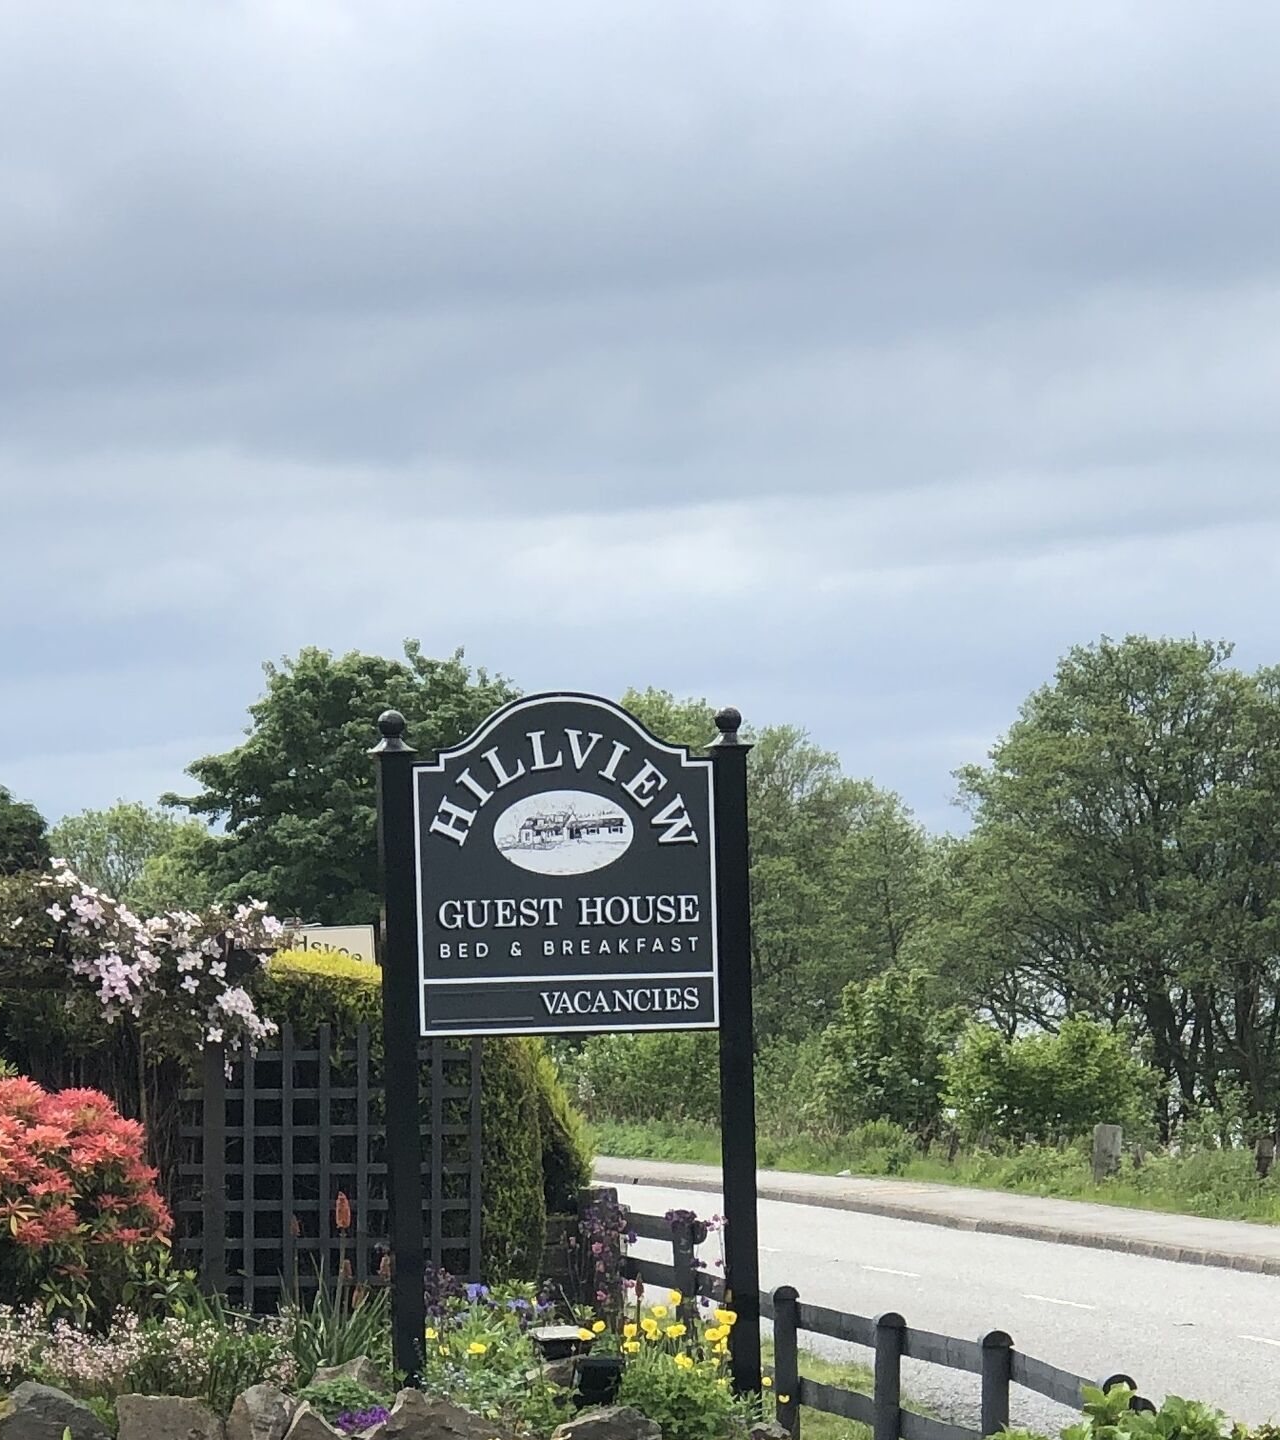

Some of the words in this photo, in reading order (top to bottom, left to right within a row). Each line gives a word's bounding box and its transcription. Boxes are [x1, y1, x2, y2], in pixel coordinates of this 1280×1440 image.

[429, 728, 699, 846] HILLVIEW
[438, 898, 563, 929] GUEST
[578, 894, 700, 925] HOUSE
[440, 942, 489, 958] BED
[510, 941, 522, 957] &
[543, 937, 700, 954] BREAKFAST
[540, 987, 700, 1015] VACANCIES
